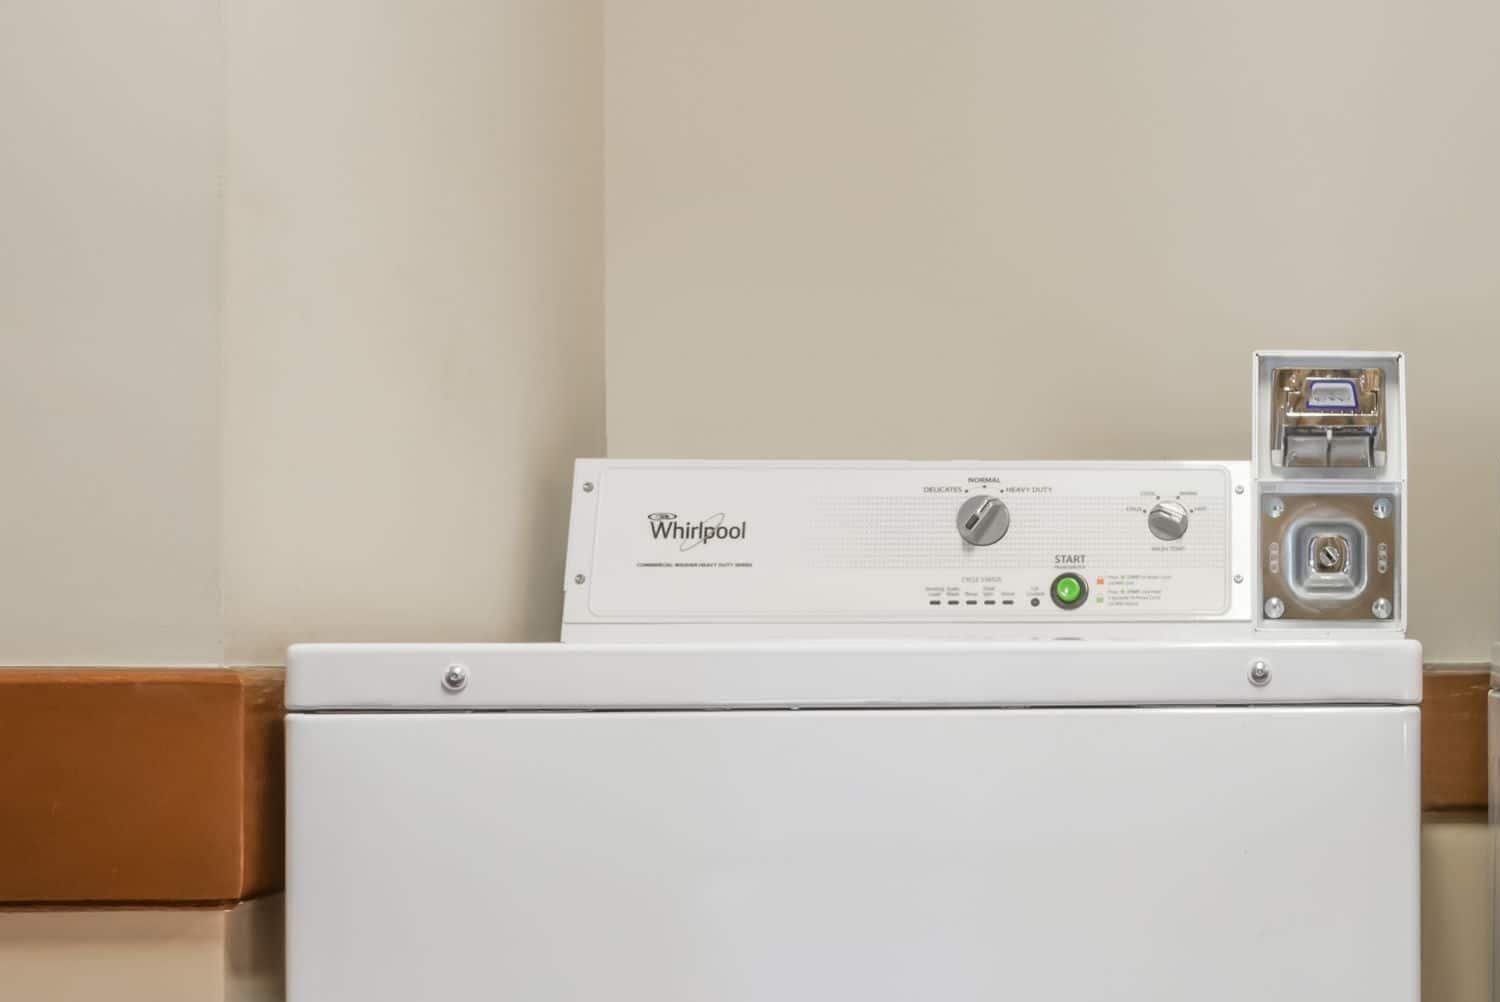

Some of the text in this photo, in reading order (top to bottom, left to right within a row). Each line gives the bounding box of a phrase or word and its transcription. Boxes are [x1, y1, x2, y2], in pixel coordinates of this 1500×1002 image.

[967, 476, 1001, 484] NORMAL
[922, 486, 963, 494] DELICATES
[1005, 486, 1053, 494] HEAVY DUTY
[650, 520, 746, 544] Whirlpool
[1055, 554, 1086, 564] START
